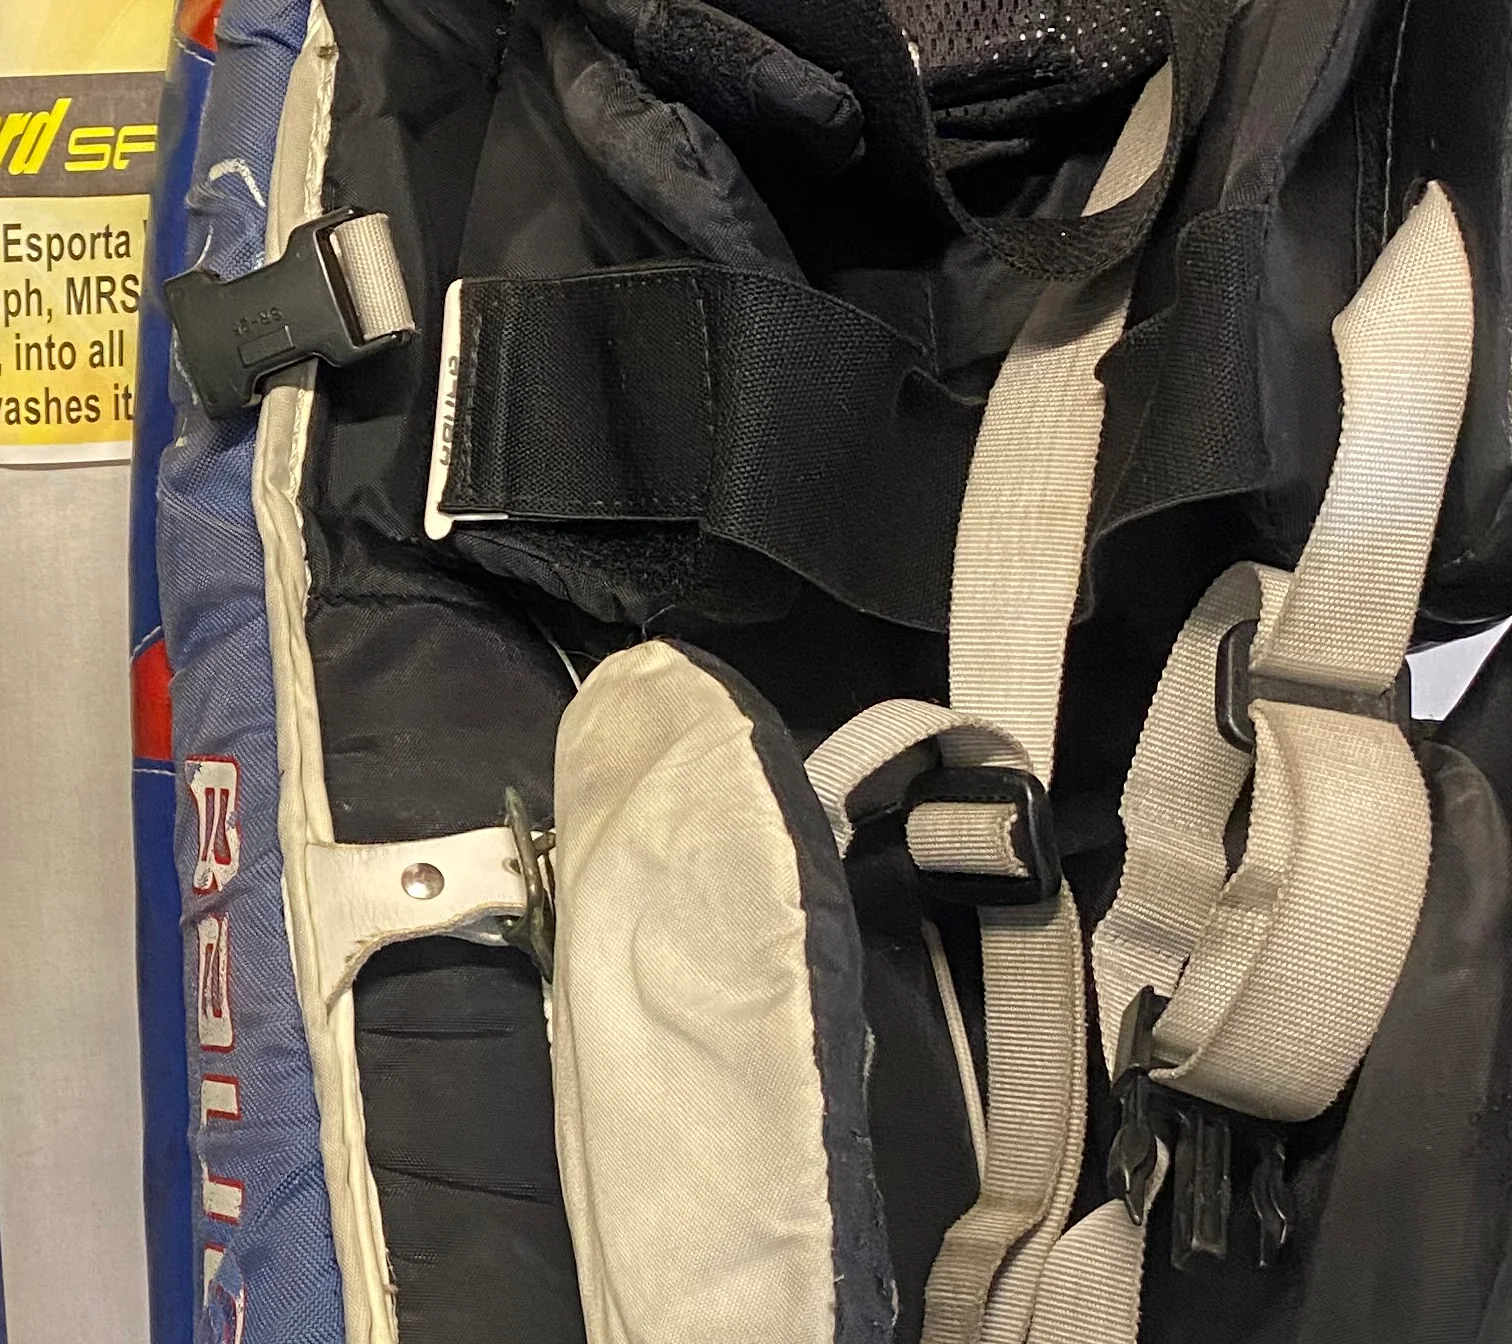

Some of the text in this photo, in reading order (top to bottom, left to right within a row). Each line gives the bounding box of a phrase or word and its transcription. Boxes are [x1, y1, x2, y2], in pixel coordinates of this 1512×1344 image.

[3, 222, 132, 272] Esporta
[14, 331, 77, 372] into
[88, 329, 125, 369] all
